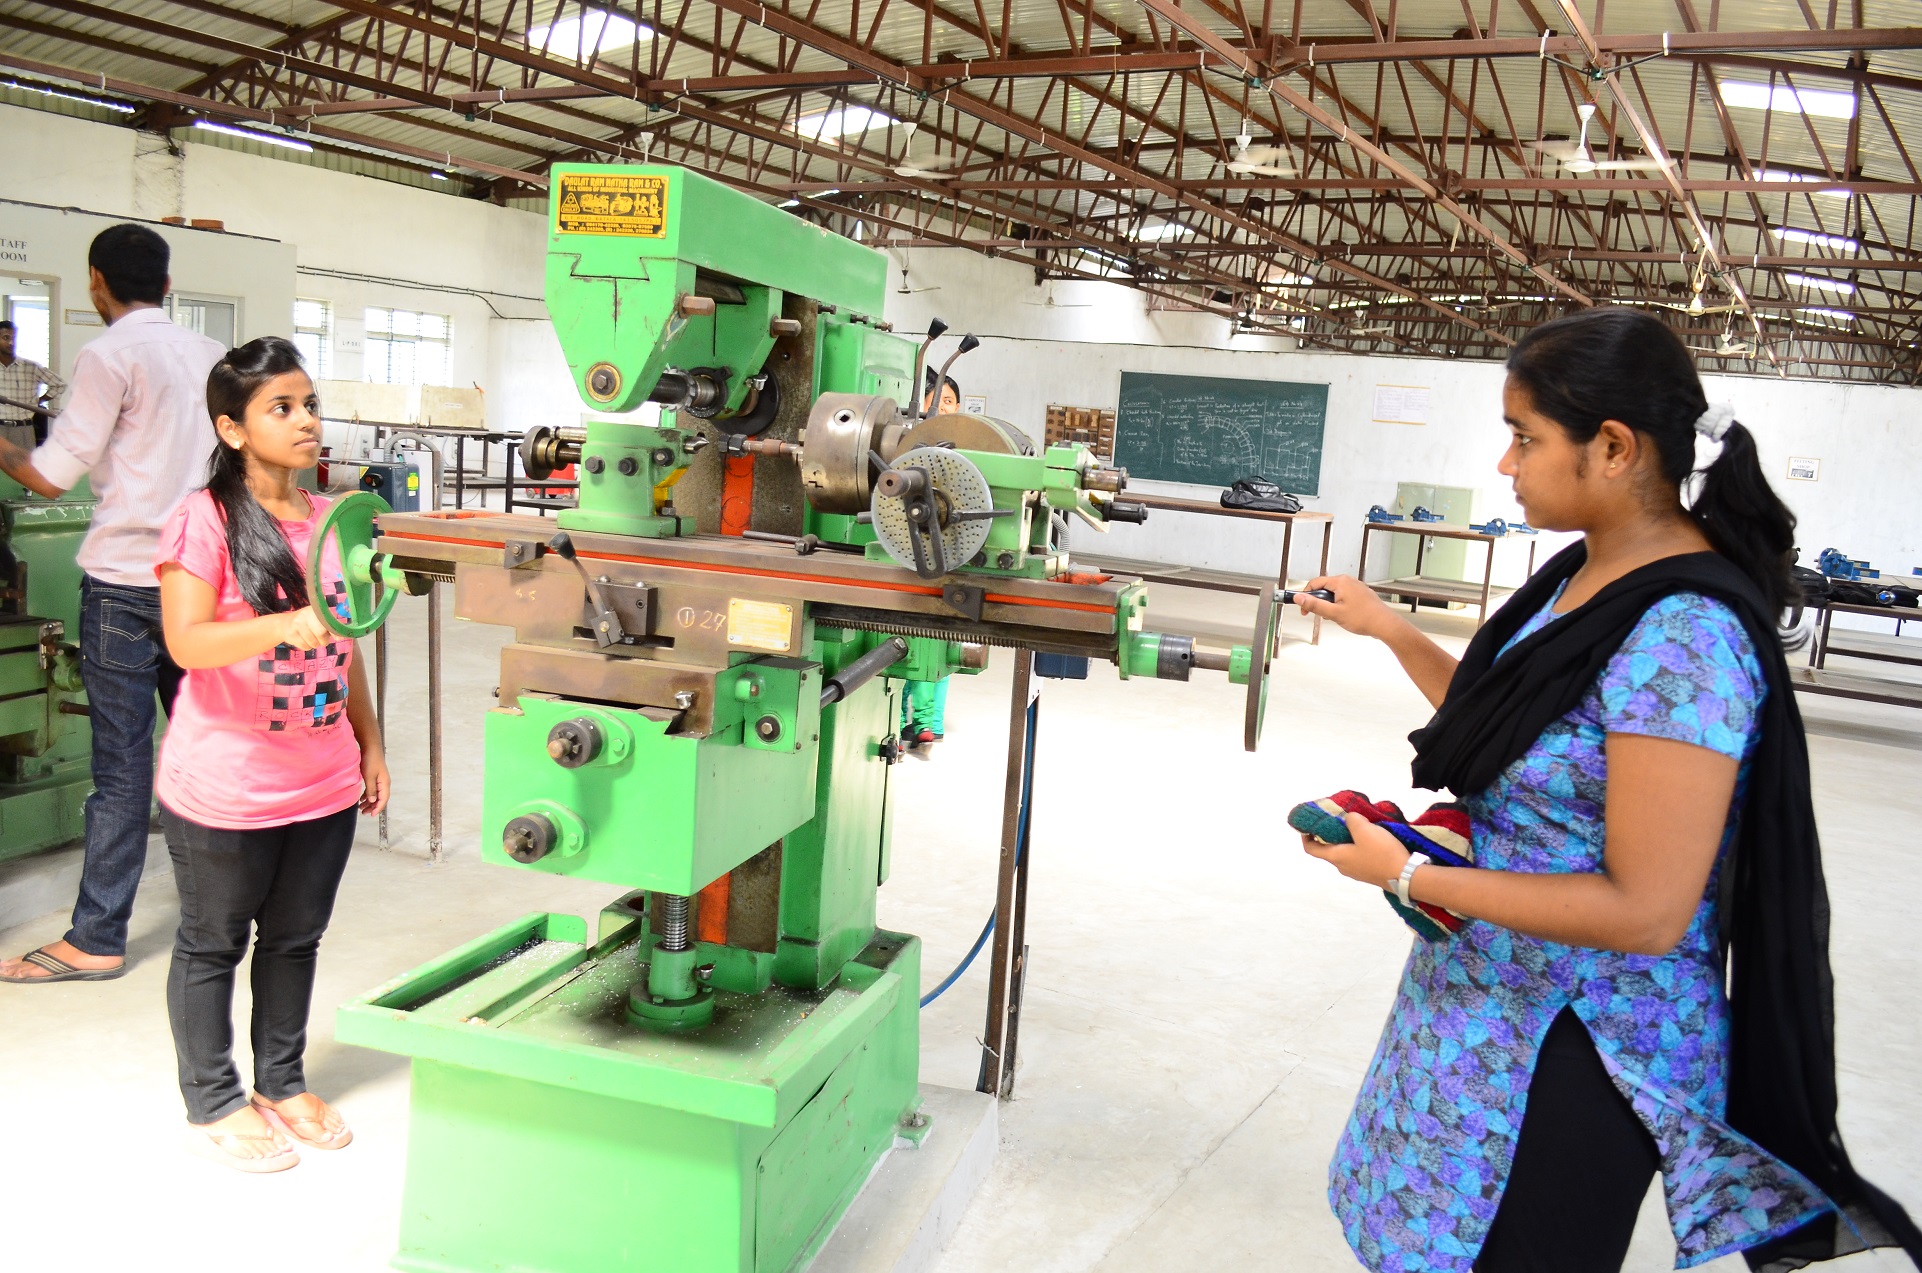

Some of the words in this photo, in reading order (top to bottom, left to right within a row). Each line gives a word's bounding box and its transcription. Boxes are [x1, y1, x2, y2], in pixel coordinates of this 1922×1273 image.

[590, 178, 604, 187] RAM
[629, 179, 643, 188] RAM
[645, 179, 651, 188] &
[652, 179, 662, 189] CO.
[0, 238, 27, 249] TAFF
[0, 251, 27, 262] OOM
[278, 659, 336, 670] CRAZY
[260, 711, 313, 720] ROCK
